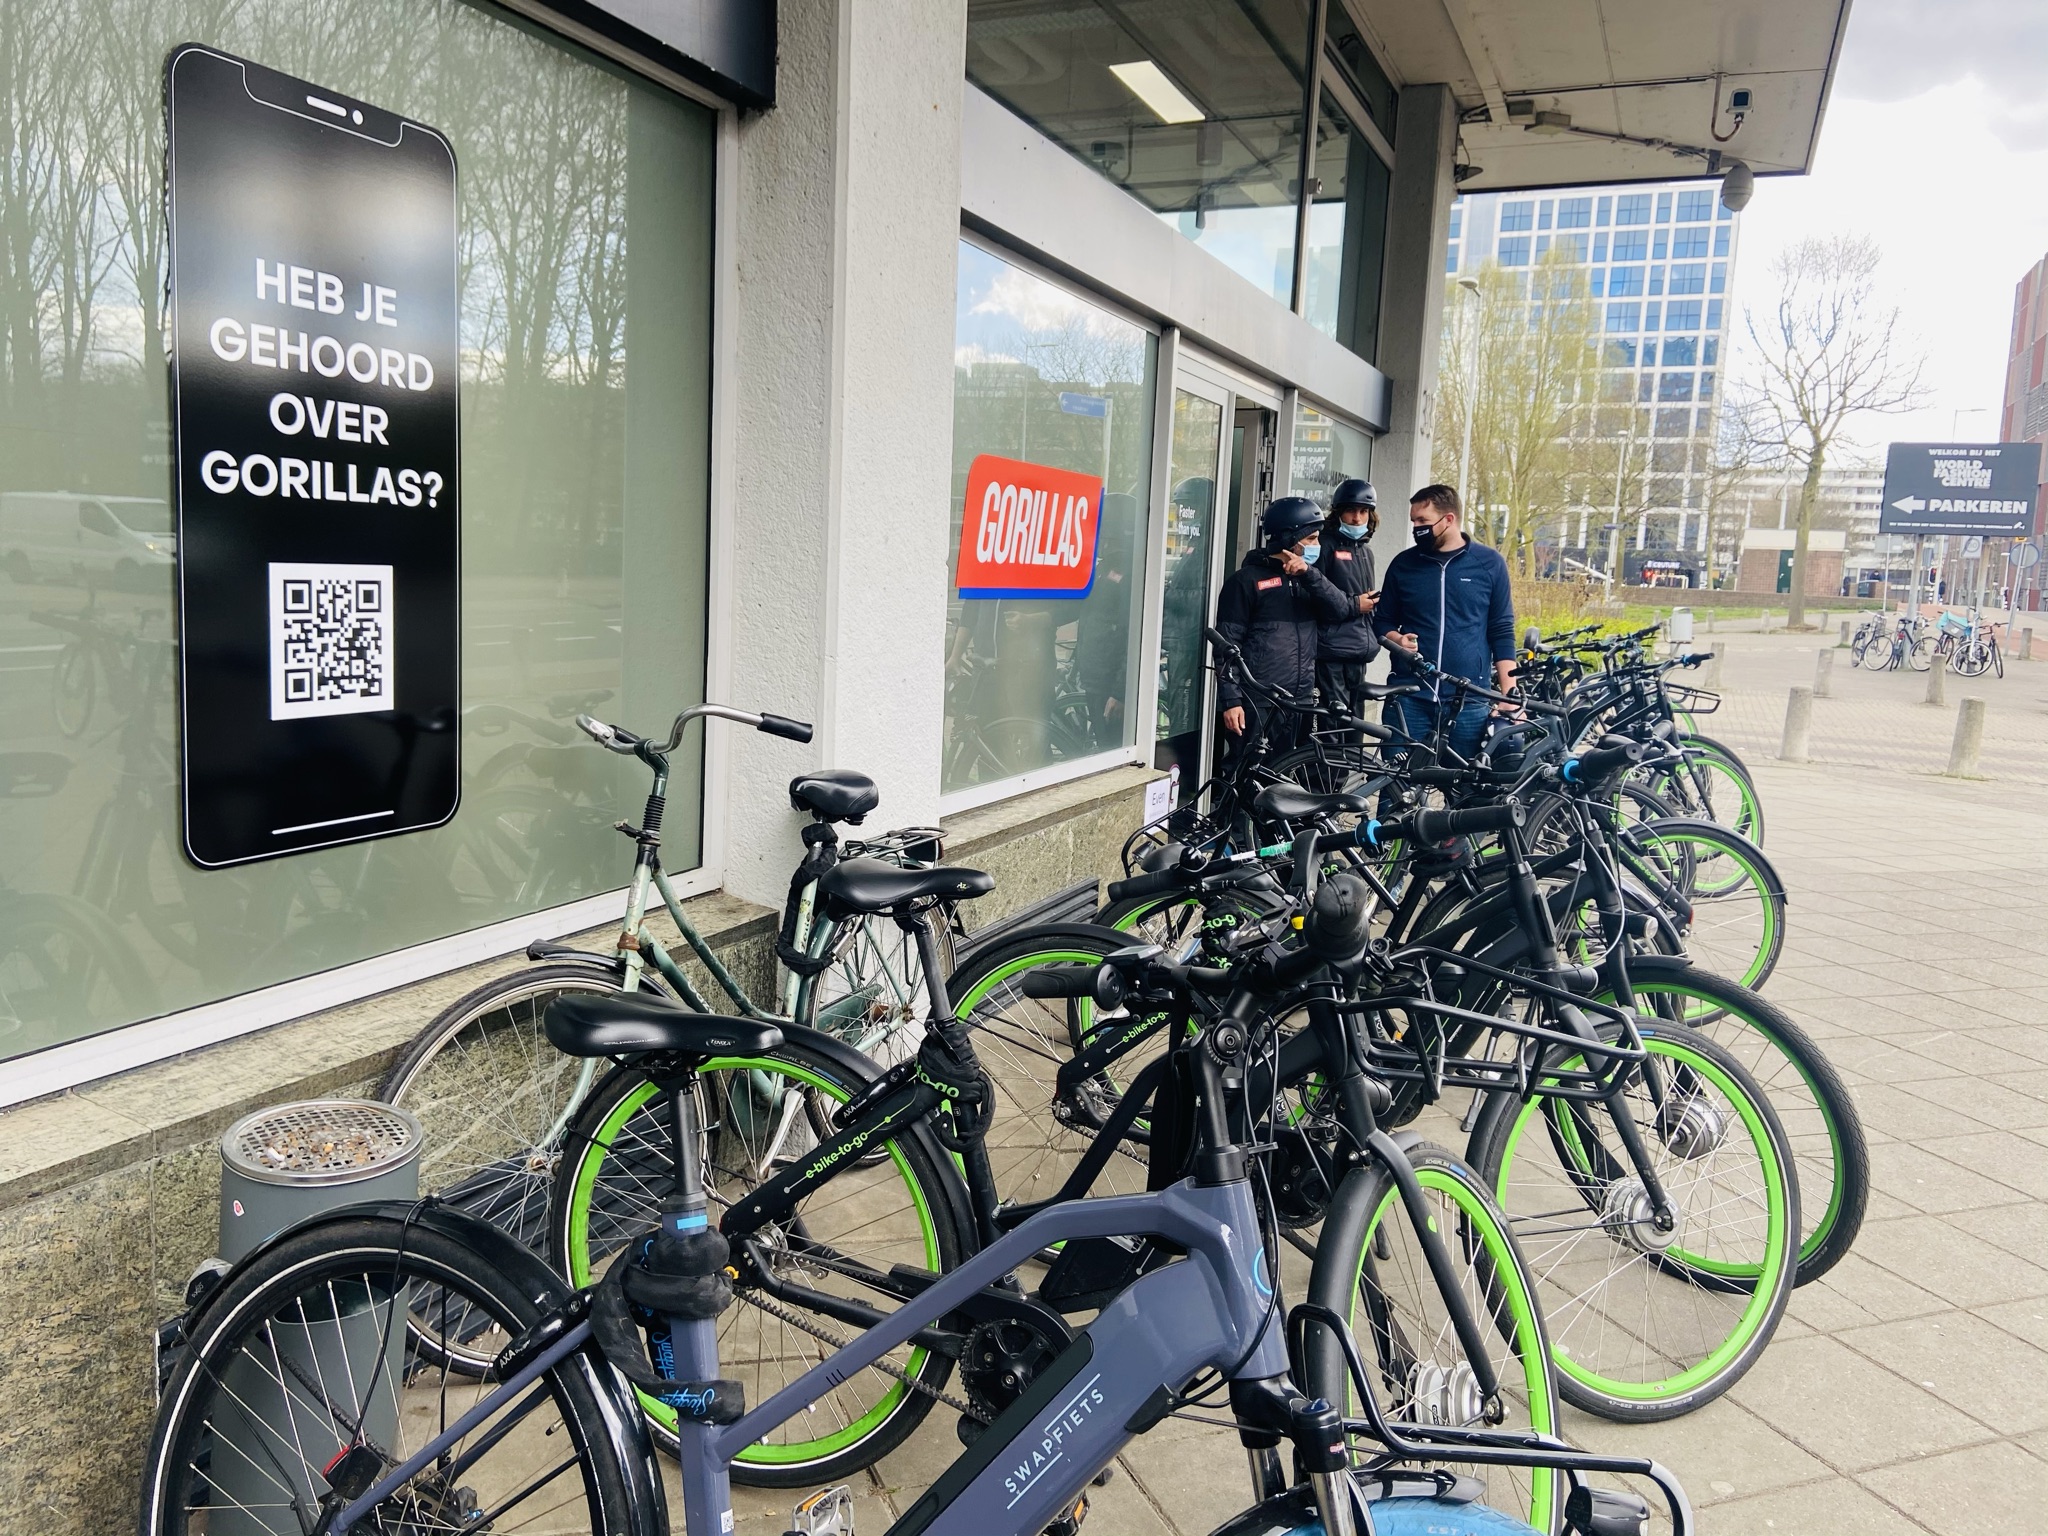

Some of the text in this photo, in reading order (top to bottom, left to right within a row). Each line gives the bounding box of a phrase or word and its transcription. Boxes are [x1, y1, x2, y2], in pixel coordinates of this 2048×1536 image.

[255, 257, 398, 328] HEB JE
[209, 316, 435, 392] GEHOORD
[268, 391, 390, 446] OVER
[1928, 448, 1967, 456] WELKOM
[1984, 449, 2002, 457] HET
[1933, 459, 1983, 469] WORLD
[200, 449, 444, 509] GORILLAS?
[1933, 468, 1992, 479] FASHION
[1941, 477, 1992, 487] CENTRE
[1179, 504, 1196, 519] Faster
[1928, 499, 2028, 514] PARKEREN
[975, 480, 1089, 569] GORILLAS
[1178, 521, 1201, 540] than you.
[770, 1051, 813, 1069] CHWALBE
[842, 1105, 857, 1120] AXA
[804, 1130, 870, 1180] e-bike-to-go
[499, 1349, 516, 1369] AXA
[1004, 1388, 1104, 1493] SWAPFIETS
[1427, 1525, 1460, 1535] CST
